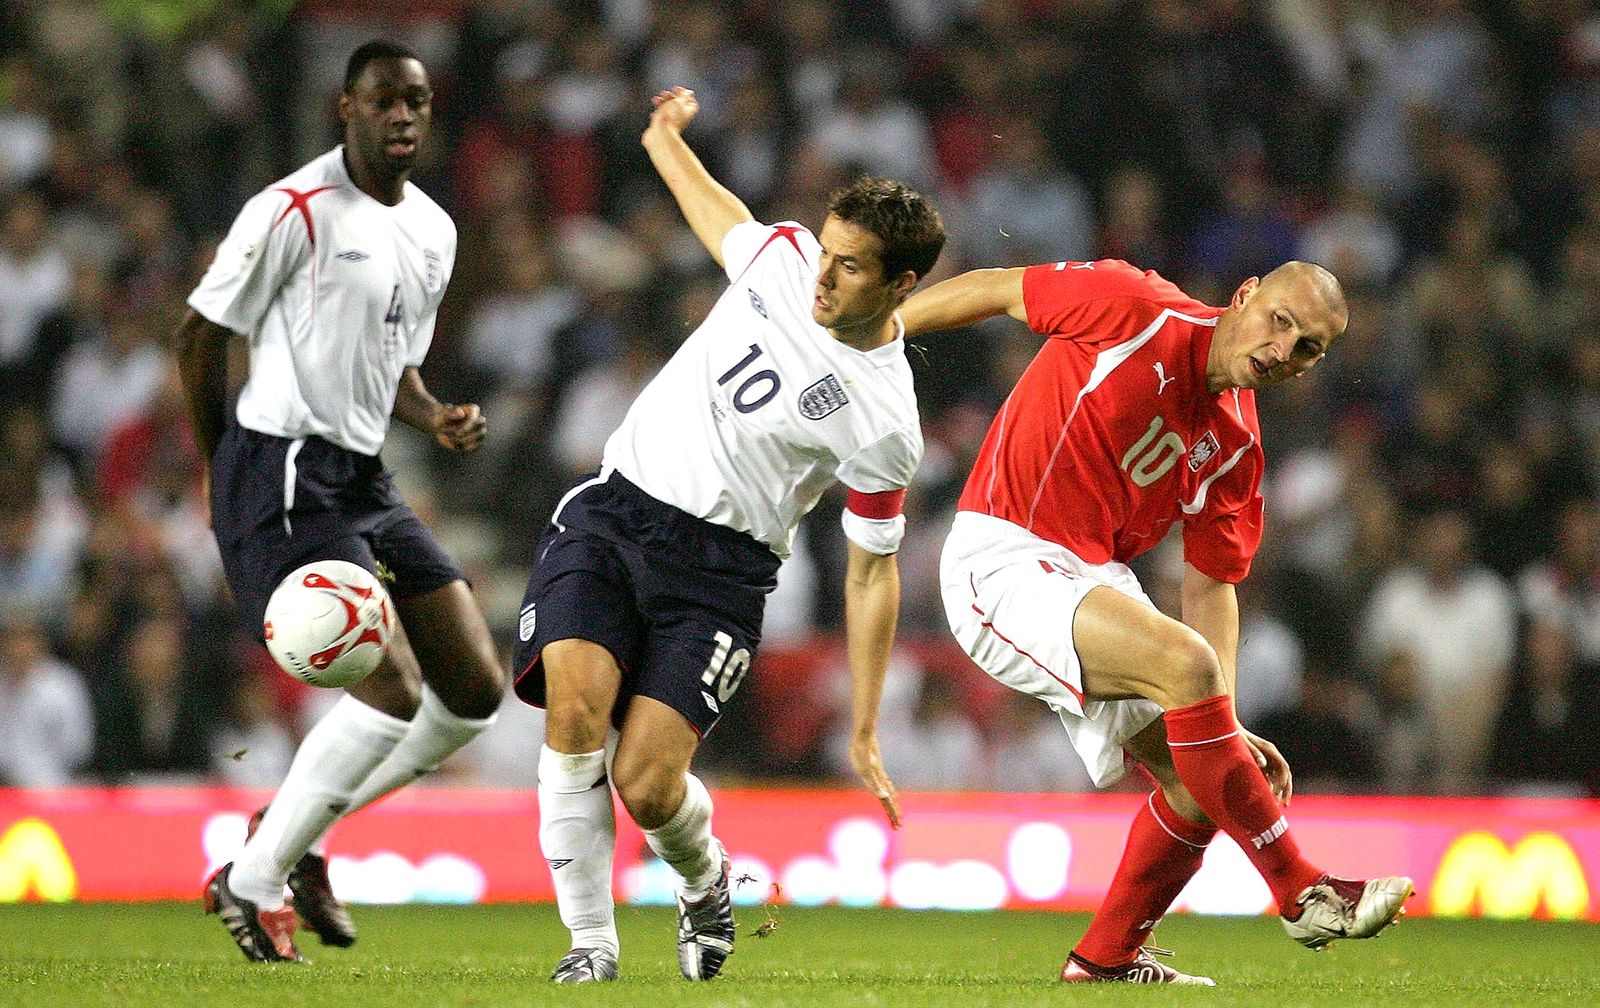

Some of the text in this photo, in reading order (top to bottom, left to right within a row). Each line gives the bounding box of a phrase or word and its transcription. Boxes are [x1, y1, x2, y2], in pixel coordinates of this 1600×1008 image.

[717, 343, 782, 414] 10
[1120, 415, 1187, 488] 10
[700, 630, 751, 703] 10
